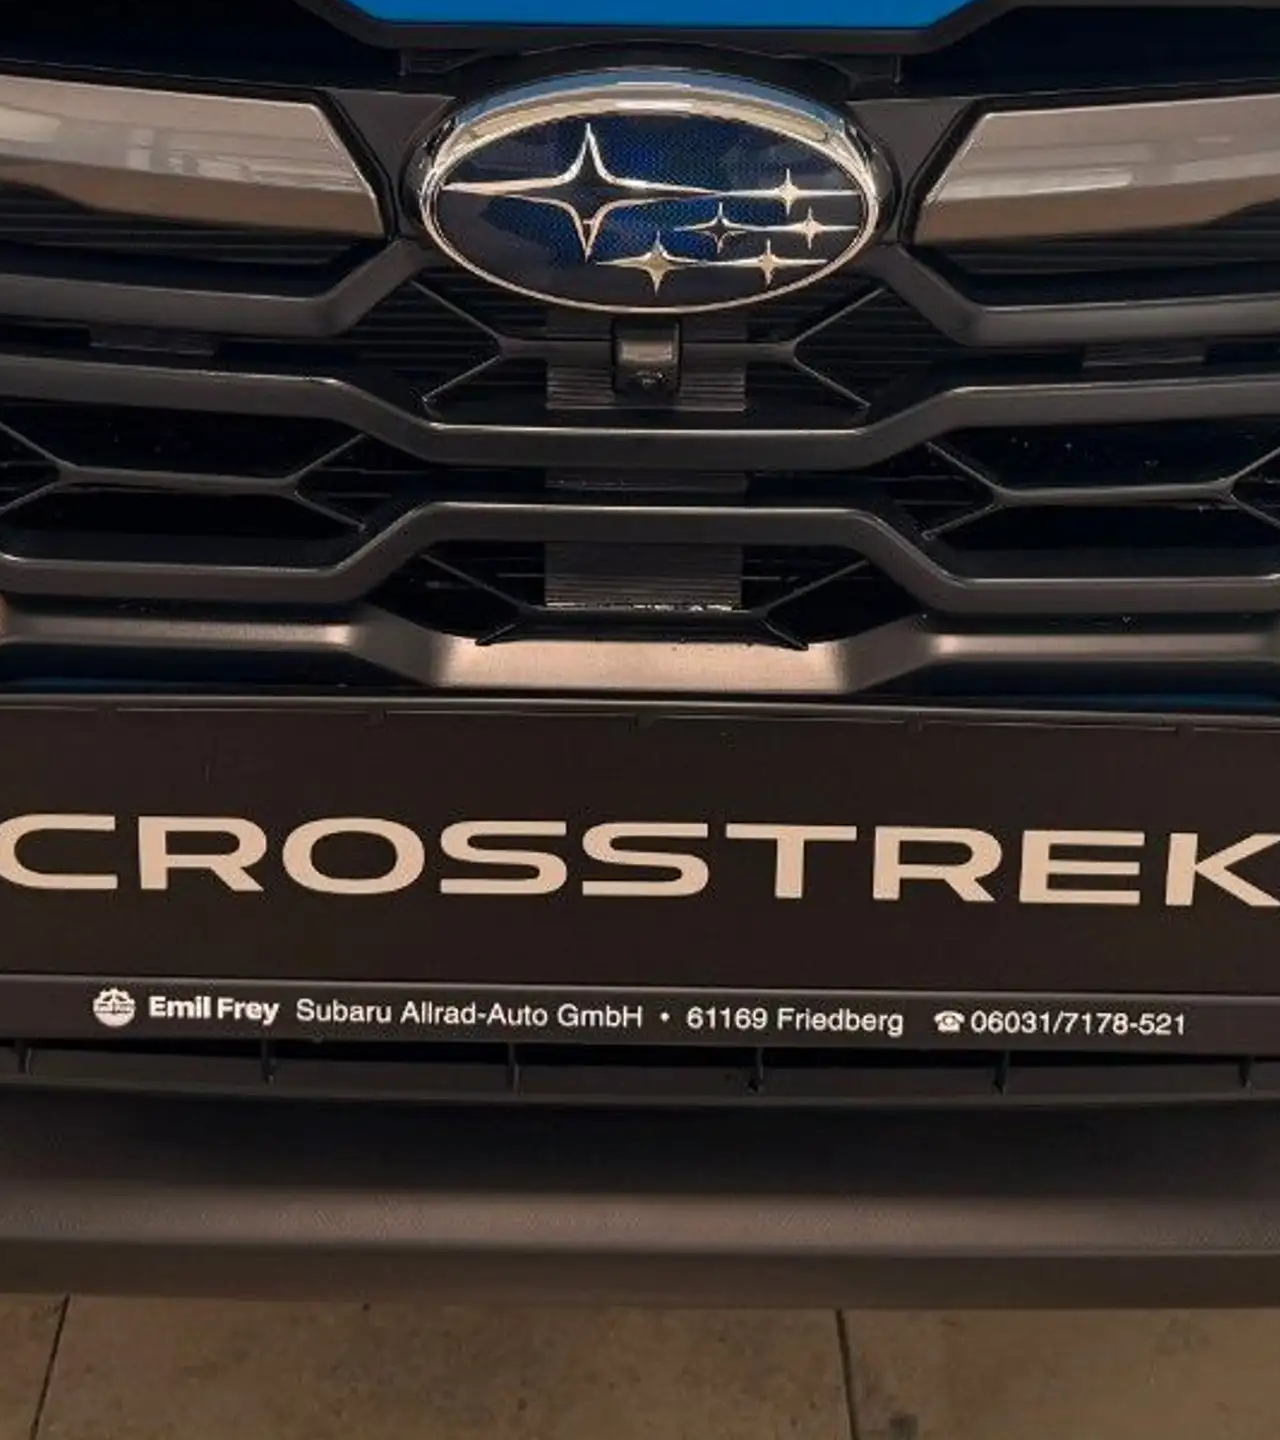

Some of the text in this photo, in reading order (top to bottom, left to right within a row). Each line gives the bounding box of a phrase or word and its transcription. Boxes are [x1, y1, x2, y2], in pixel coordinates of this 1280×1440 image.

[148, 995, 212, 1019] Emil
[216, 996, 280, 1026] Frey
[296, 997, 392, 1024] Subaru
[399, 1000, 549, 1027] Allrad-Auto
[556, 1002, 643, 1028] GmbH
[686, 1005, 768, 1030] 61169
[777, 1007, 904, 1038] Friedberg
[970, 1009, 1185, 1036] 06031/7178-521
